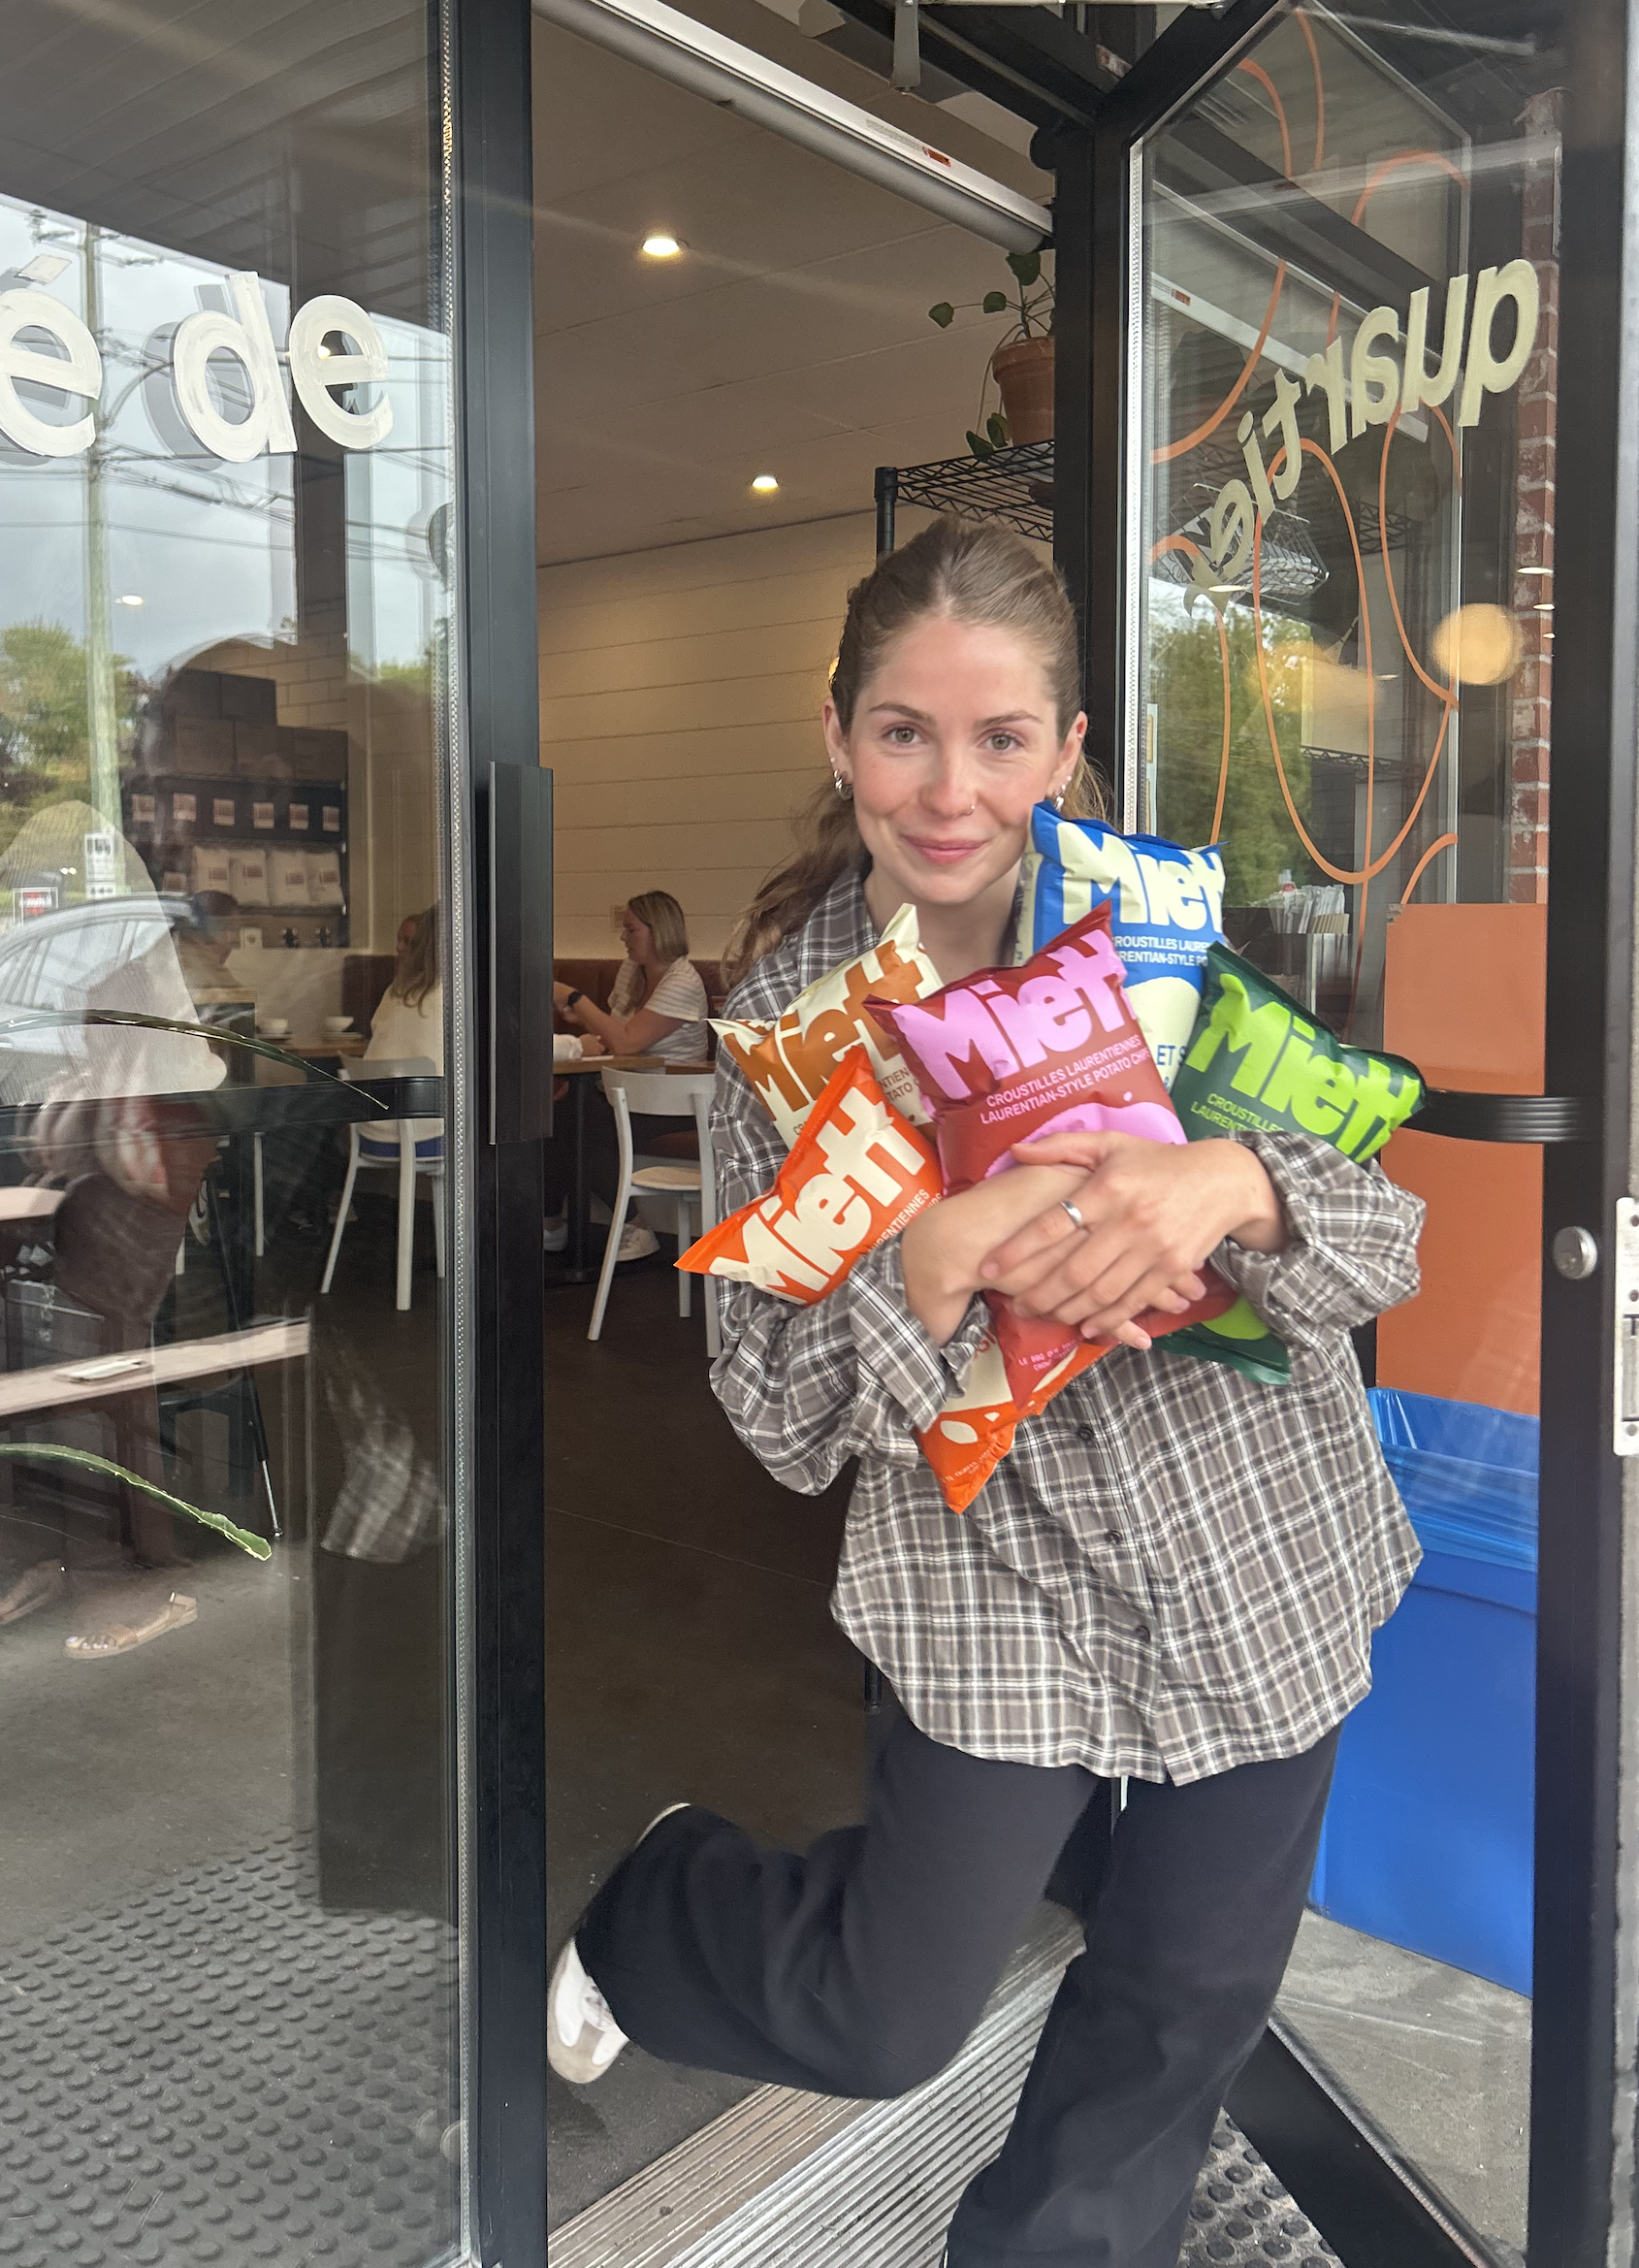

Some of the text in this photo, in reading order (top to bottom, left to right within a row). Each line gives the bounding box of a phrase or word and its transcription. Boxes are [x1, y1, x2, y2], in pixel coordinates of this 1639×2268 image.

[173, 271, 395, 463] de
[1112, 935, 1177, 950] ROUSTILLES
[1117, 950, 1195, 966] RENTIAN-STYLE
[980, 1074, 1094, 1124] LAURENTIAN-STYLE
[1092, 1056, 1132, 1082] POTATO
[986, 1034, 1141, 1107] CROUSTILLES LAURENTIENNES
[1156, 1044, 1176, 1066] ET
[1185, 973, 1420, 1163] Miett
[709, 1086, 925, 1305] Miett
